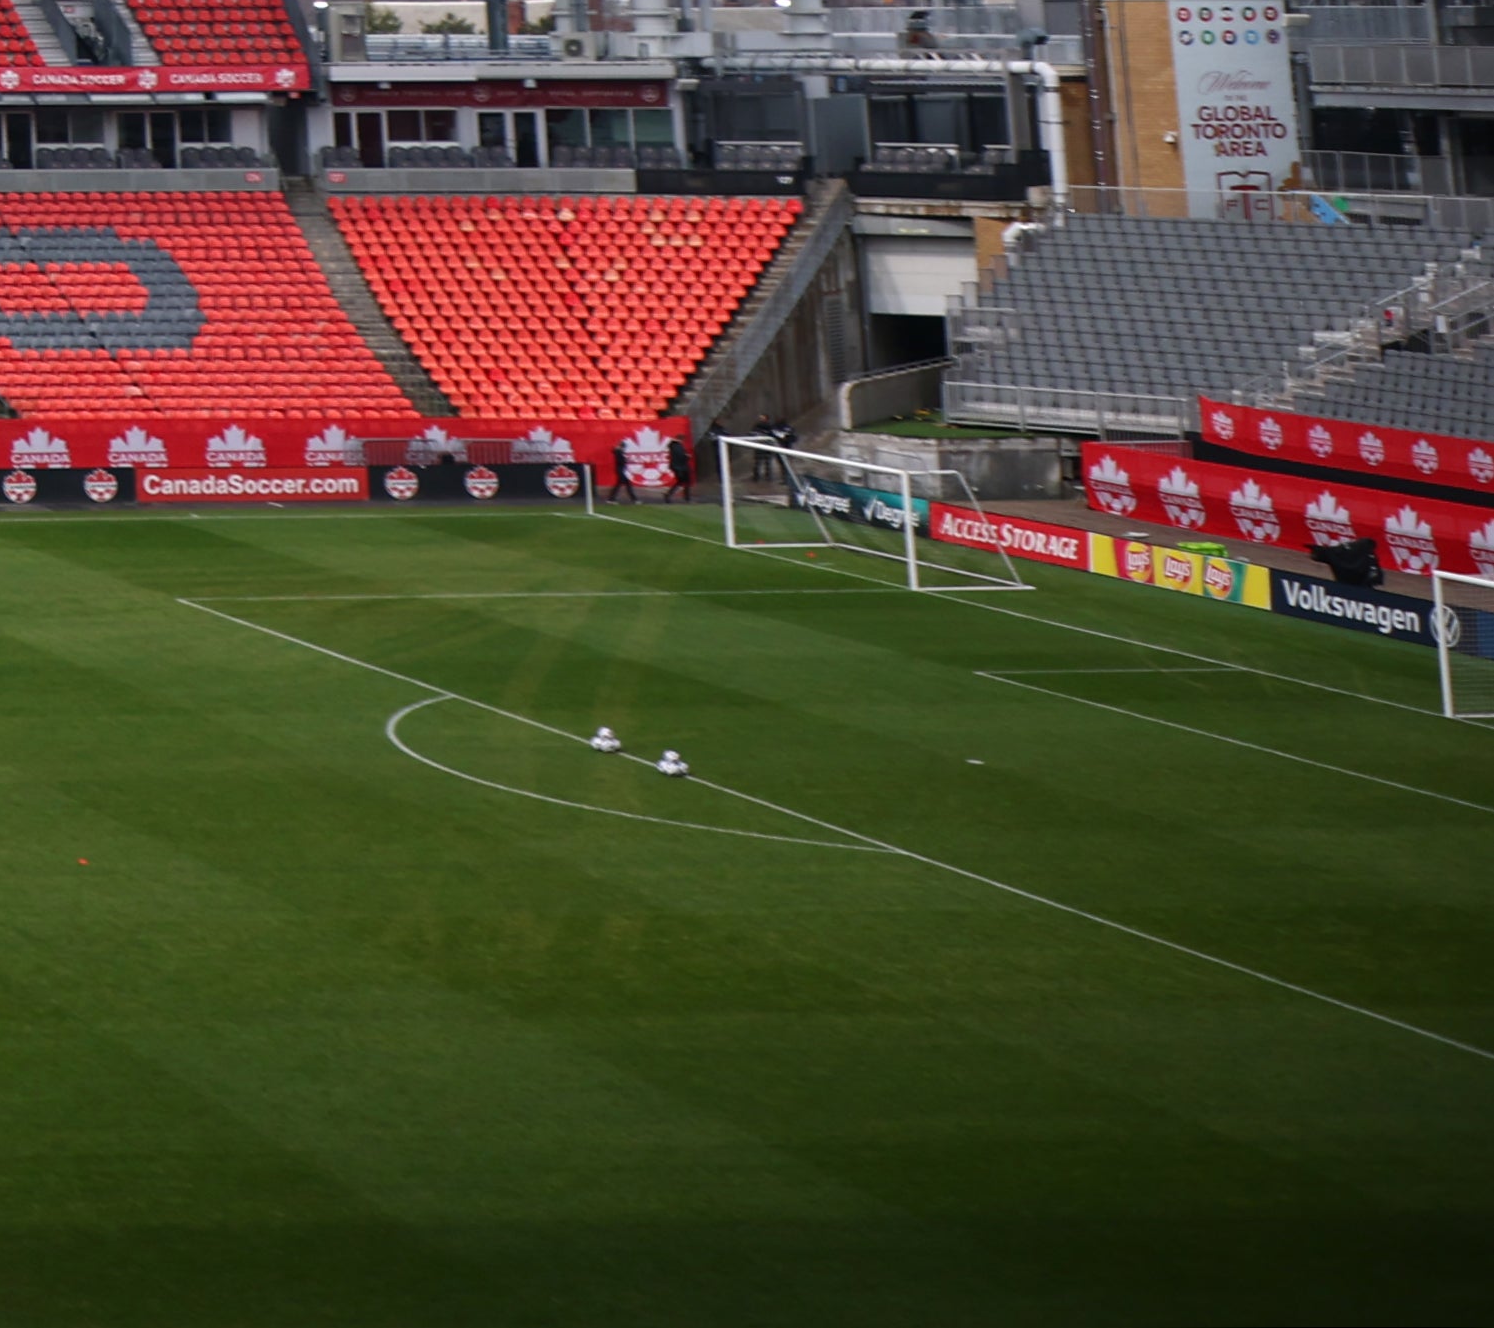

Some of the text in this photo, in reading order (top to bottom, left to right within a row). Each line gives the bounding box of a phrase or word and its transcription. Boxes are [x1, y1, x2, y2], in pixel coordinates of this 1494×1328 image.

[1197, 105, 1278, 122] GLOBAL
[1191, 123, 1287, 140] TORONTO
[1216, 141, 1268, 157] AREA
[10, 453, 70, 464] CANADA
[107, 452, 168, 462] CANADA
[205, 452, 266, 462] CANADA
[142, 474, 360, 496] CanadaSoccer.com
[1088, 481, 1134, 497] CANADA
[1157, 492, 1203, 509] CANADA
[1230, 506, 1278, 523] CANADA
[940, 512, 1078, 560] ACCESS STORAGE
[1306, 519, 1355, 537] CANADA
[1387, 533, 1438, 552] CANADA
[1280, 579, 1421, 634] Volkswagen
